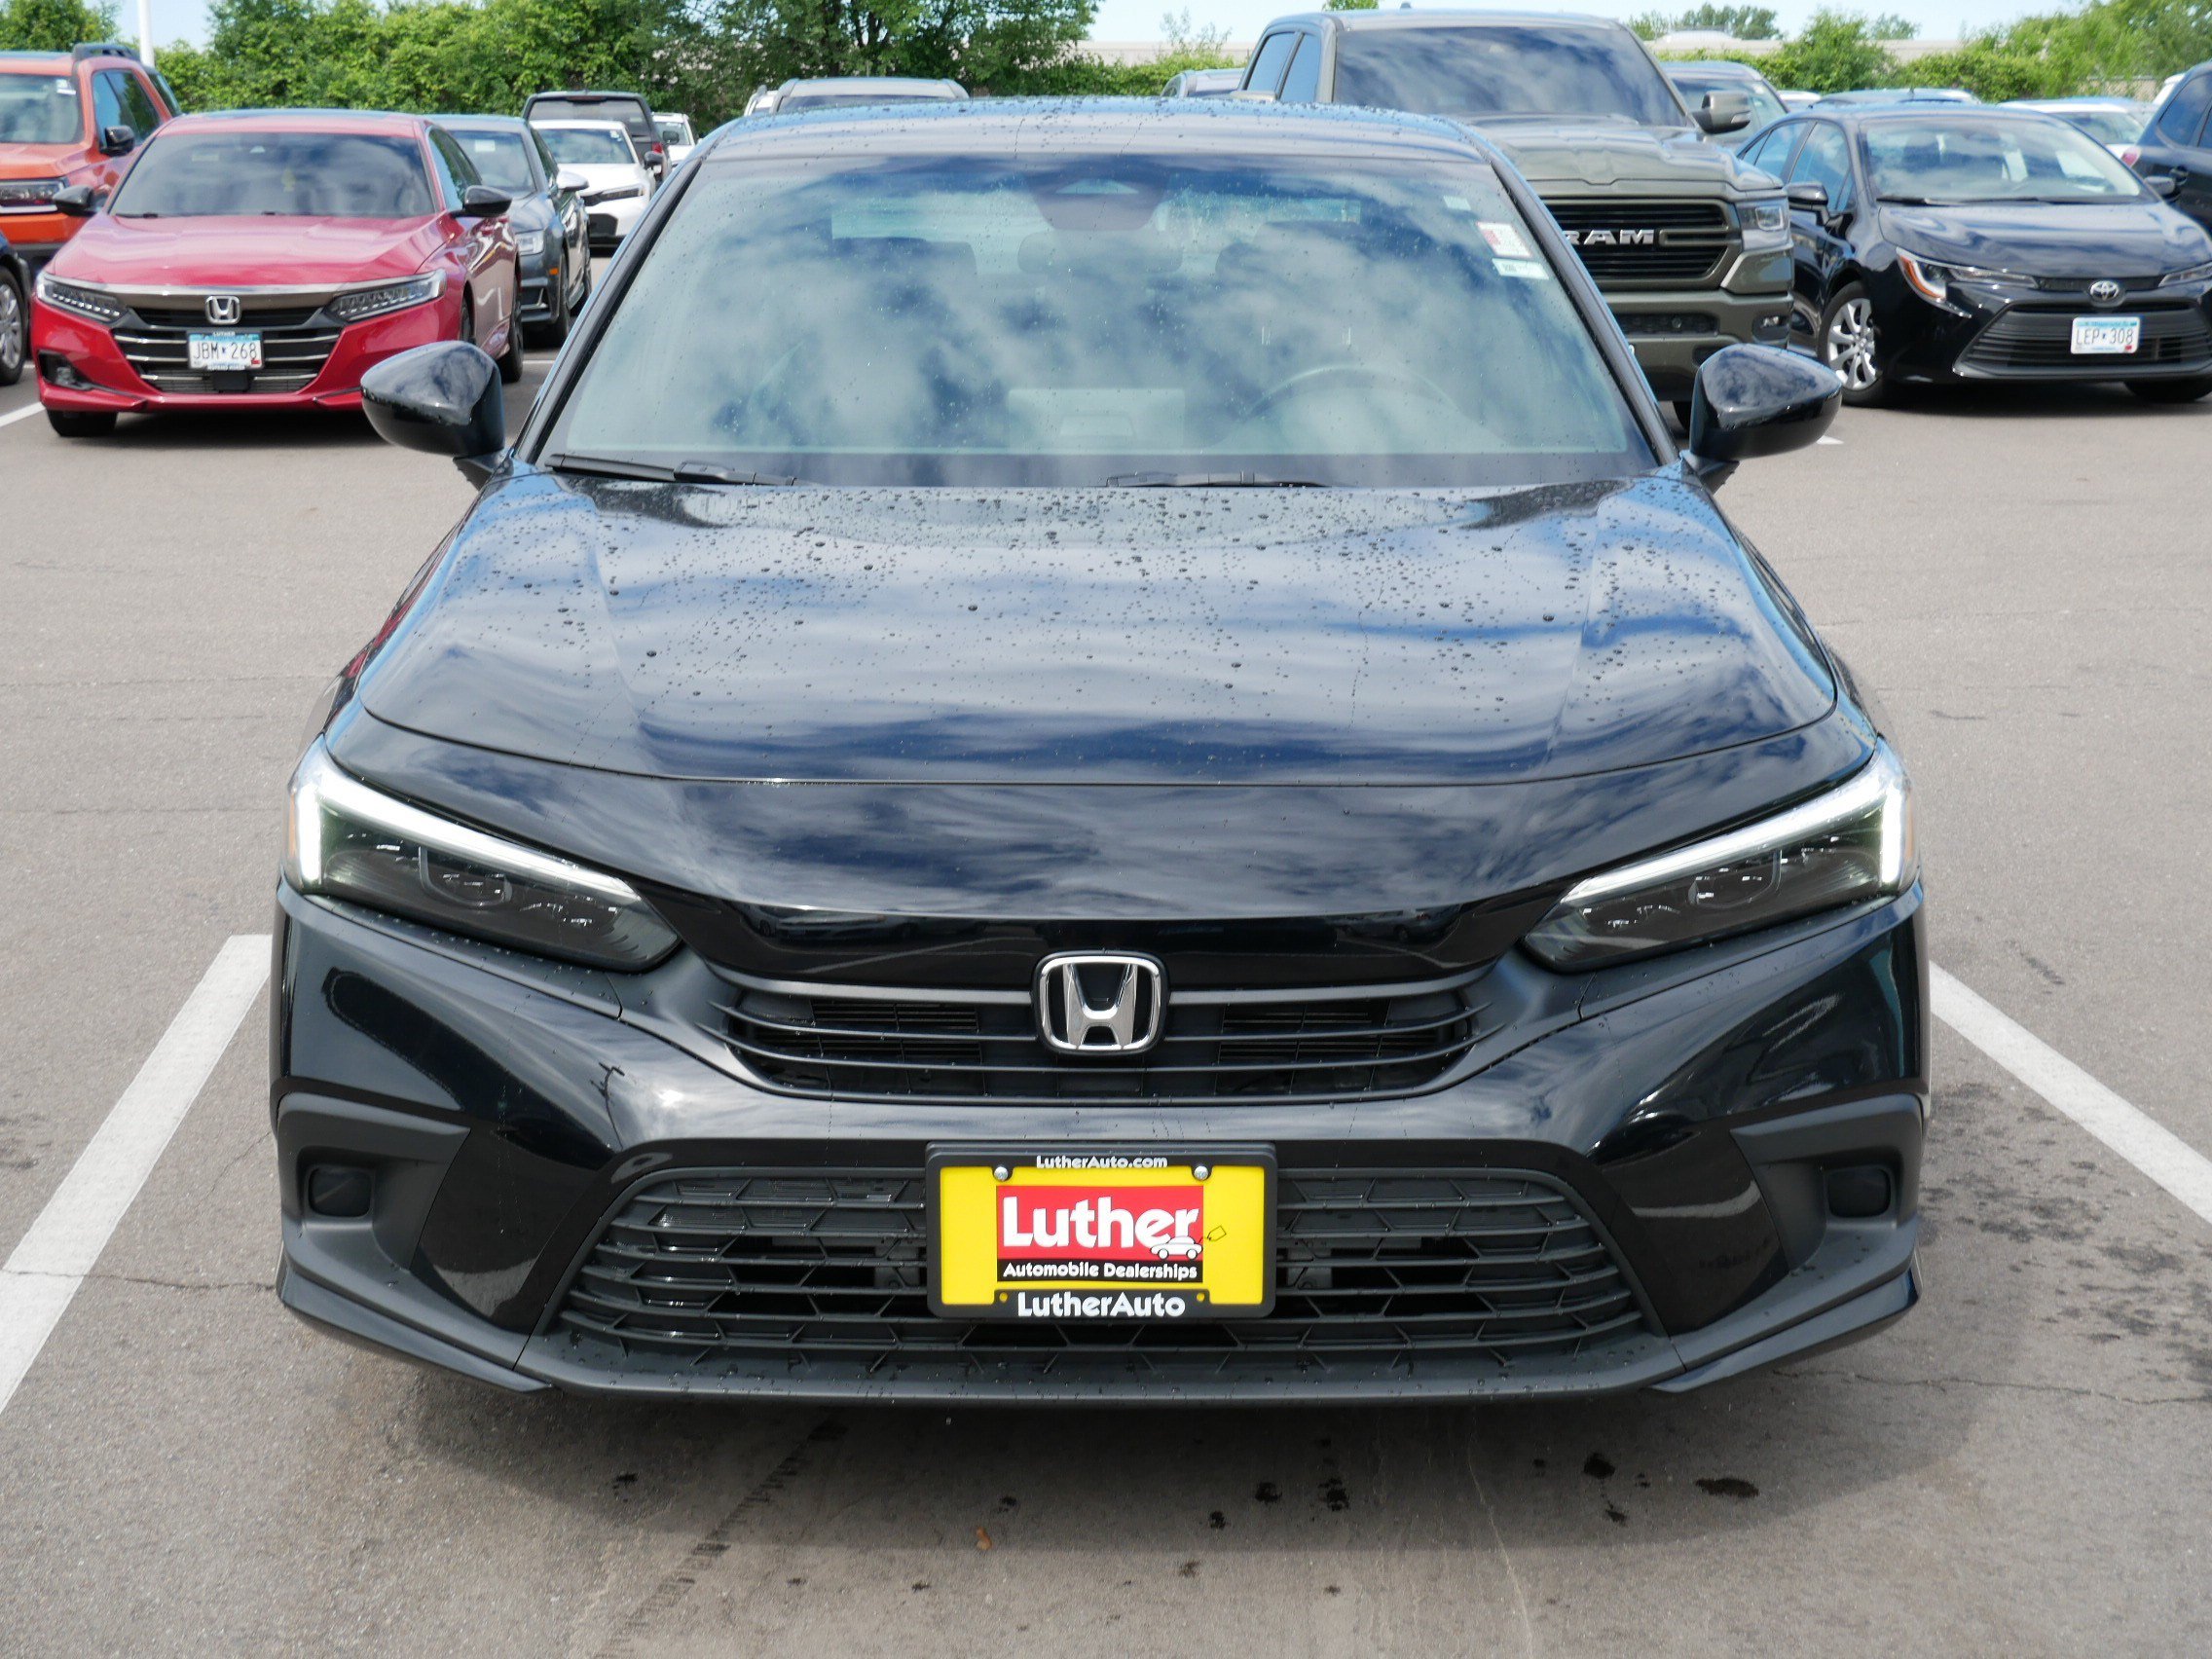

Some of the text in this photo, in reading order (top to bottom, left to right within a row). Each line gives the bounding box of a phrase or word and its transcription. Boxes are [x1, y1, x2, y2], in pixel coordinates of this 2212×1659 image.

[1562, 229, 1655, 245] RAM
[2076, 327, 2134, 346] LEP 308
[193, 342, 258, 360] JBM 268
[1035, 1155, 1169, 1169] LutherAuto.com
[1002, 1196, 1200, 1249] Luther
[1003, 1262, 1198, 1281] Automobile Dealerships
[1016, 1290, 1187, 1318] LutherAuto
